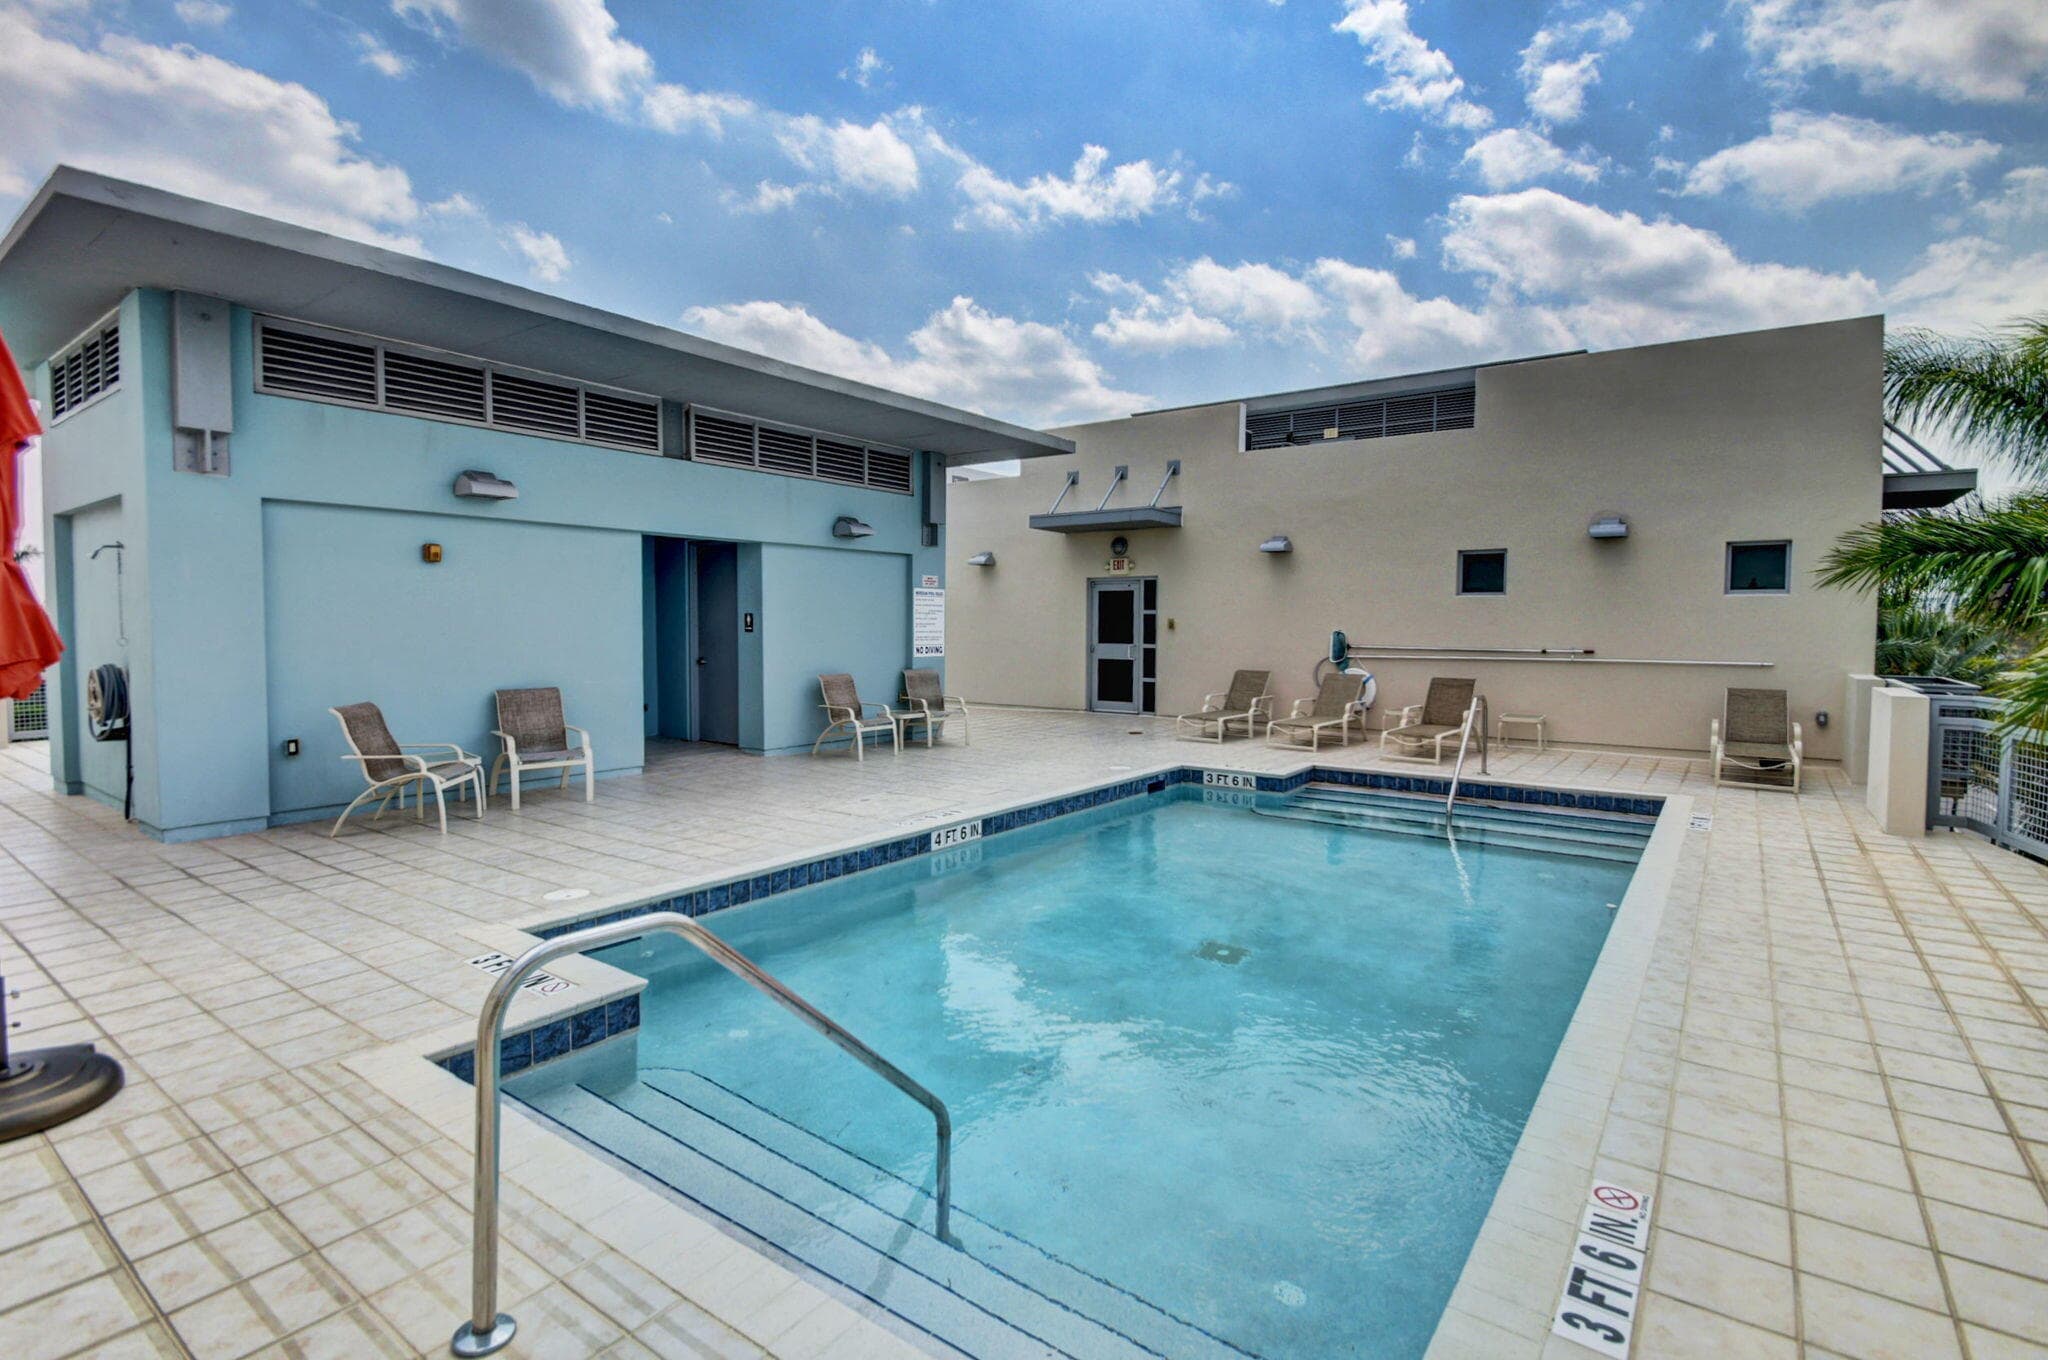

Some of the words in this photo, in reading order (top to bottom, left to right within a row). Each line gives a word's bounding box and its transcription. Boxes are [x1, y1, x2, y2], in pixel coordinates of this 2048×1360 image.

[1113, 560, 1125, 570] EXIT
[916, 646, 924, 654] NO
[925, 646, 943, 654] DIVING
[1206, 773, 1214, 784] 3
[1232, 775, 1240, 786] 6
[934, 832, 941, 847] 4
[960, 826, 967, 840] 6
[472, 954, 501, 965] 3
[1589, 1212, 1639, 1245] IN.
[1579, 1244, 1638, 1271] 6
[1561, 1311, 1626, 1344] 3
